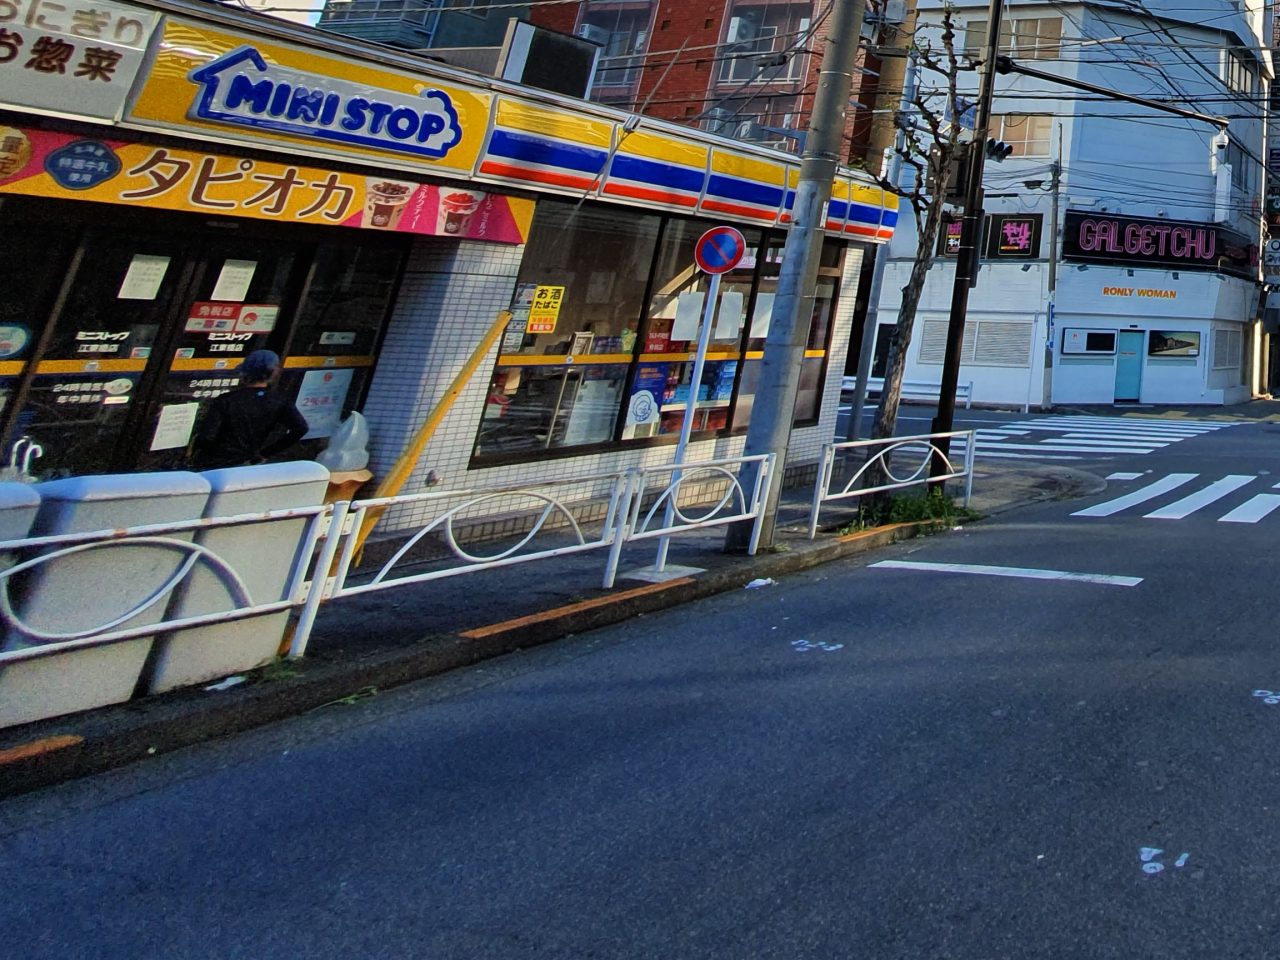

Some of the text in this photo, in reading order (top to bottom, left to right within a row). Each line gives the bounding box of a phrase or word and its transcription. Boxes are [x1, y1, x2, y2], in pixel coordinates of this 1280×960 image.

[341, 94, 446, 143] STOP
[119, 148, 354, 221] タピオカ
[537, 288, 562, 300] お酒
[1103, 287, 1177, 299] RONLY WOMAN
[534, 301, 559, 309] たばこ
[52, 382, 107, 393] 24時間営
